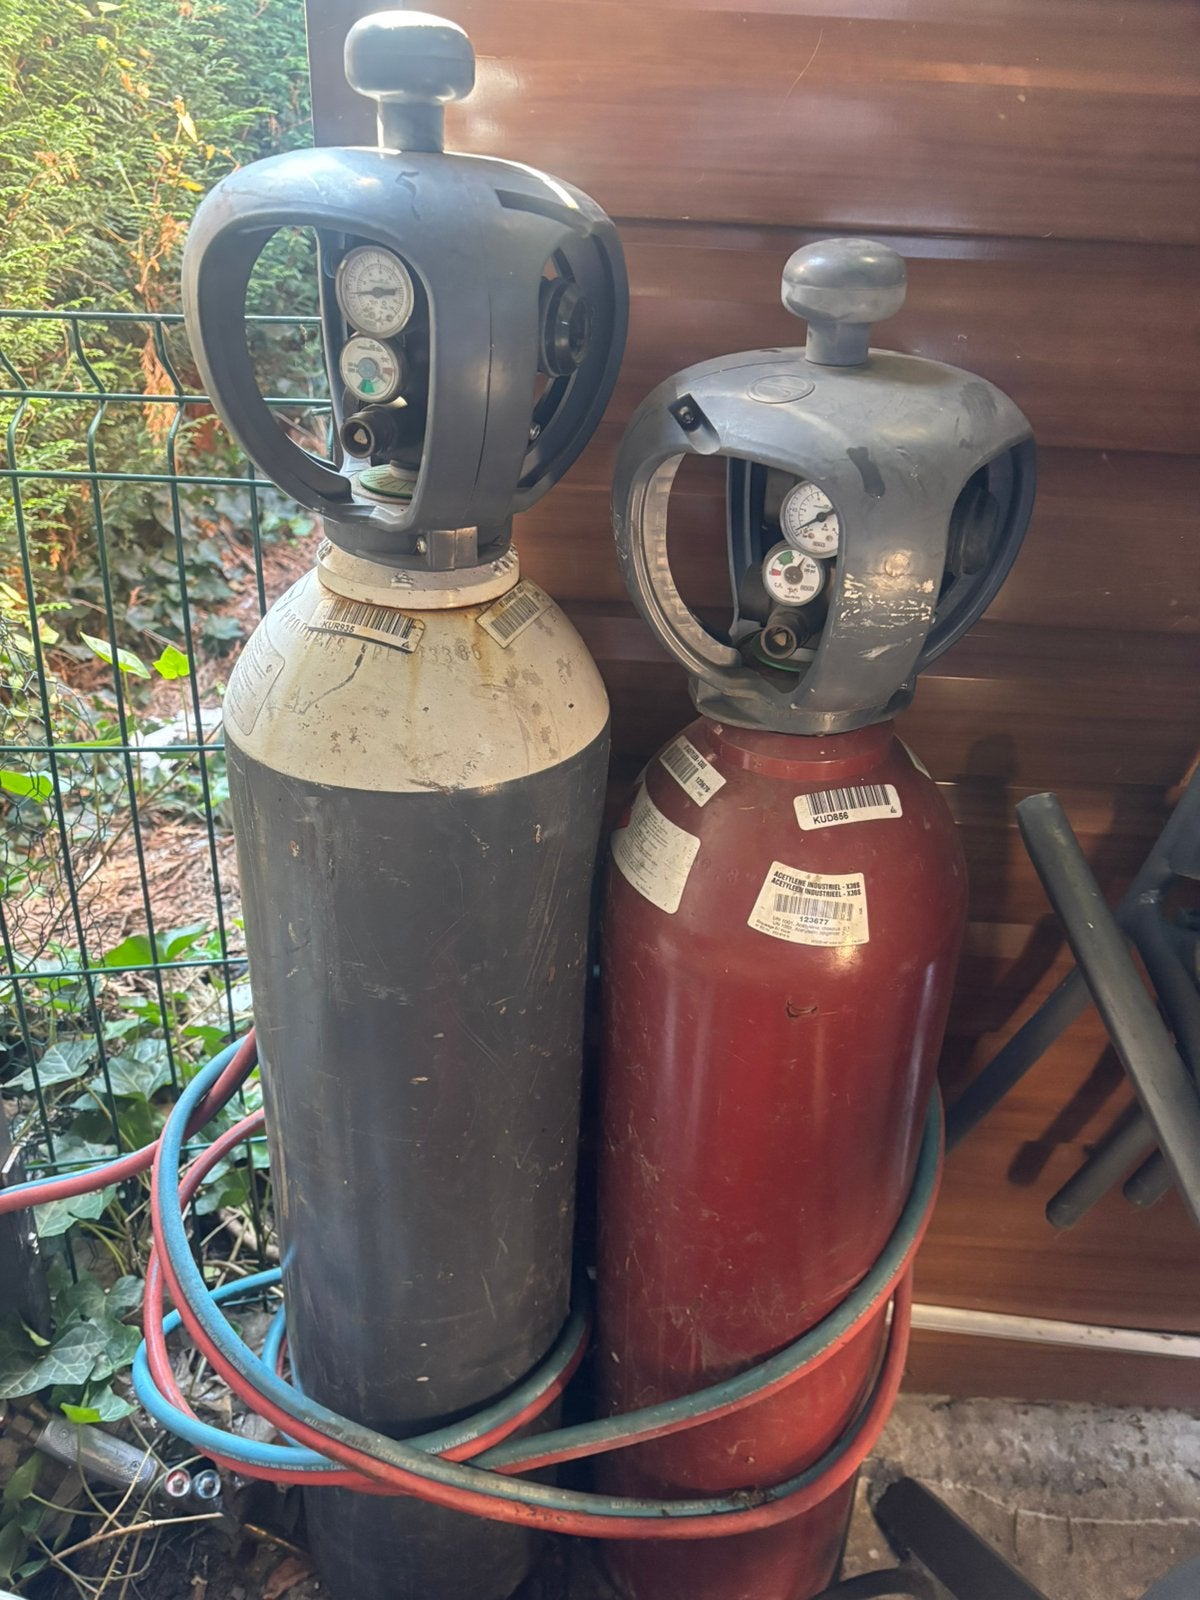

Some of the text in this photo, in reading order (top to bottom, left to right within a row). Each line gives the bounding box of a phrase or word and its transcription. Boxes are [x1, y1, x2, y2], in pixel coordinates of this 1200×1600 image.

[321, 620, 356, 634] KUR935
[812, 811, 849, 824] KUD856
[773, 870, 806, 886] ACETYLENE
[807, 880, 841, 891] INDUSTRIEL
[804, 888, 842, 898] INDUSTRIEEL
[799, 916, 830, 925] 123677
